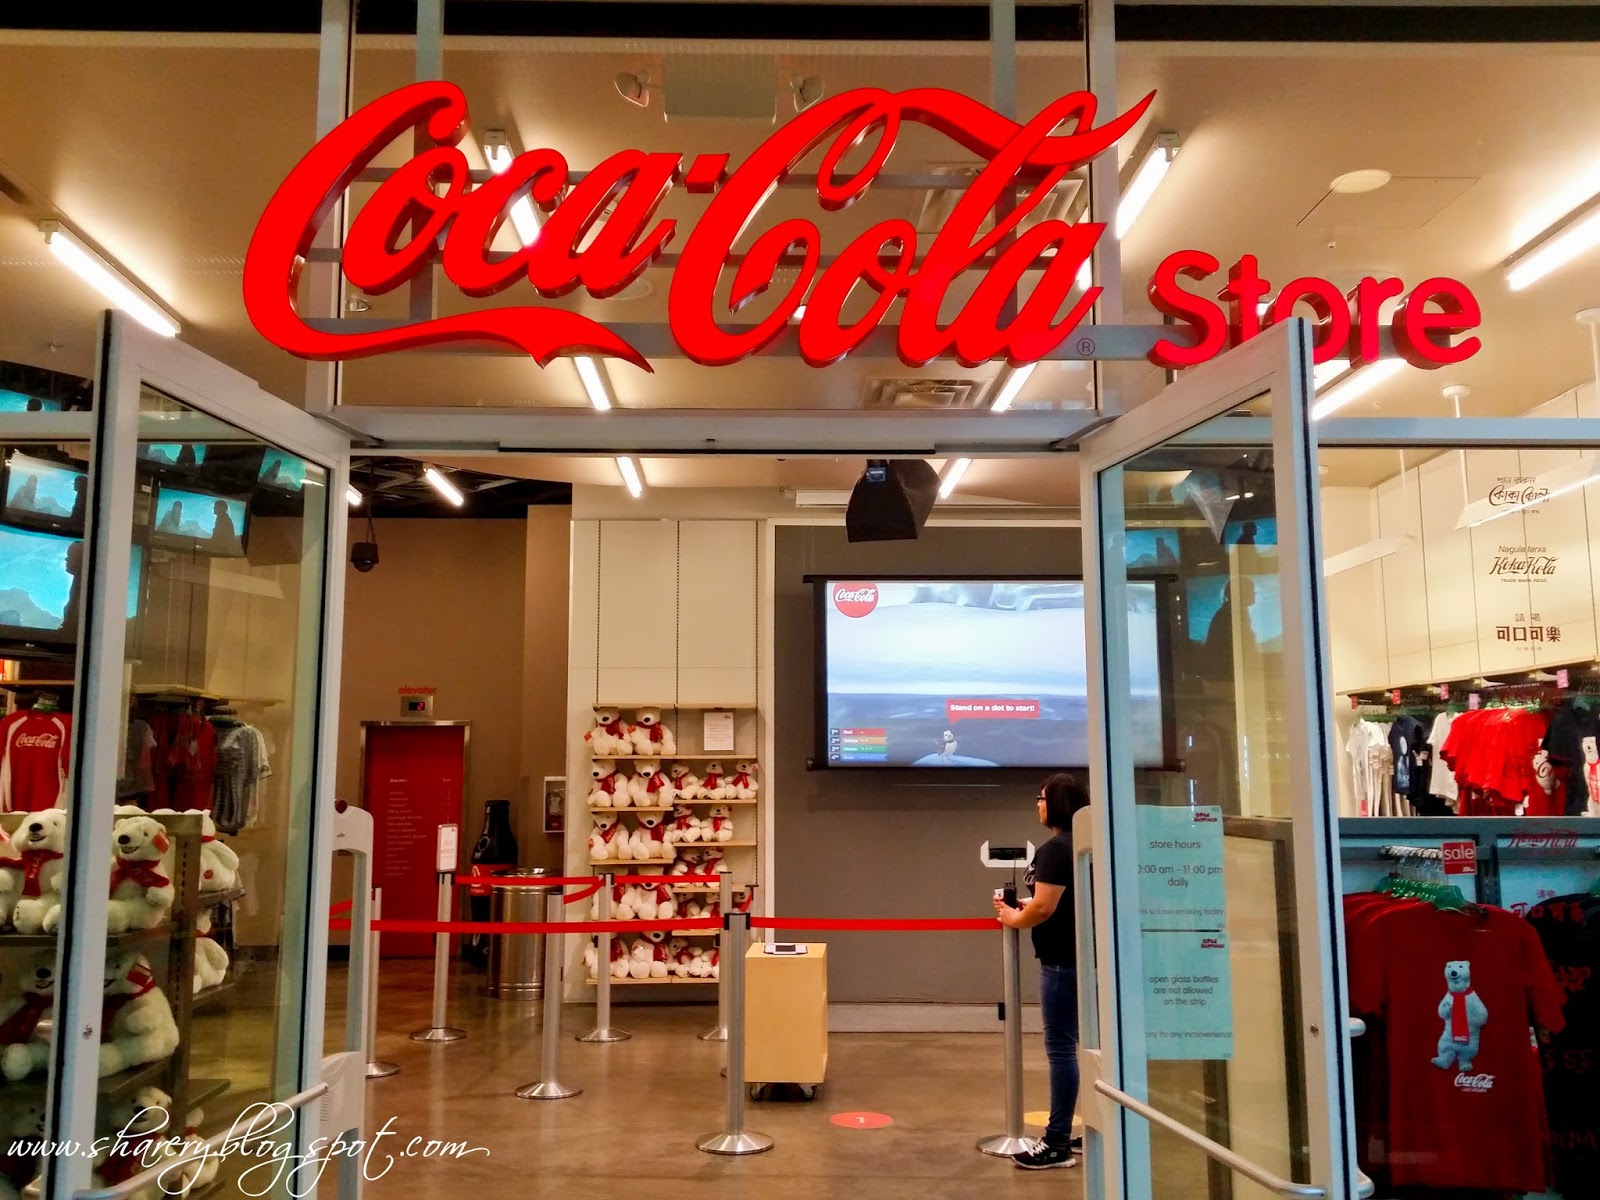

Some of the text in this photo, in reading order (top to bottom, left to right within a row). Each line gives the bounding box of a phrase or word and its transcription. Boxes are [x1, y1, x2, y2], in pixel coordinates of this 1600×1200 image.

[243, 80, 1157, 372] Coca-Cola
[1148, 250, 1482, 369] Store
[1498, 545, 1526, 555] Nagula
[835, 587, 877, 603] Coca-Cola
[1495, 625, 1561, 643] 可口可樂
[398, 685, 437, 694] elevator
[1150, 841, 1173, 849] store
[1444, 844, 1474, 860] sale
[1158, 866, 1174, 874] am
[1183, 864, 1206, 874] 11:00
[1207, 866, 1223, 876] pm
[1167, 876, 1189, 888] daily
[1149, 974, 1219, 985] open glass bottles
[1168, 986, 1181, 994] not
[1182, 986, 1213, 994] allowed
[1454, 1072, 1496, 1088] Coca-Cola
